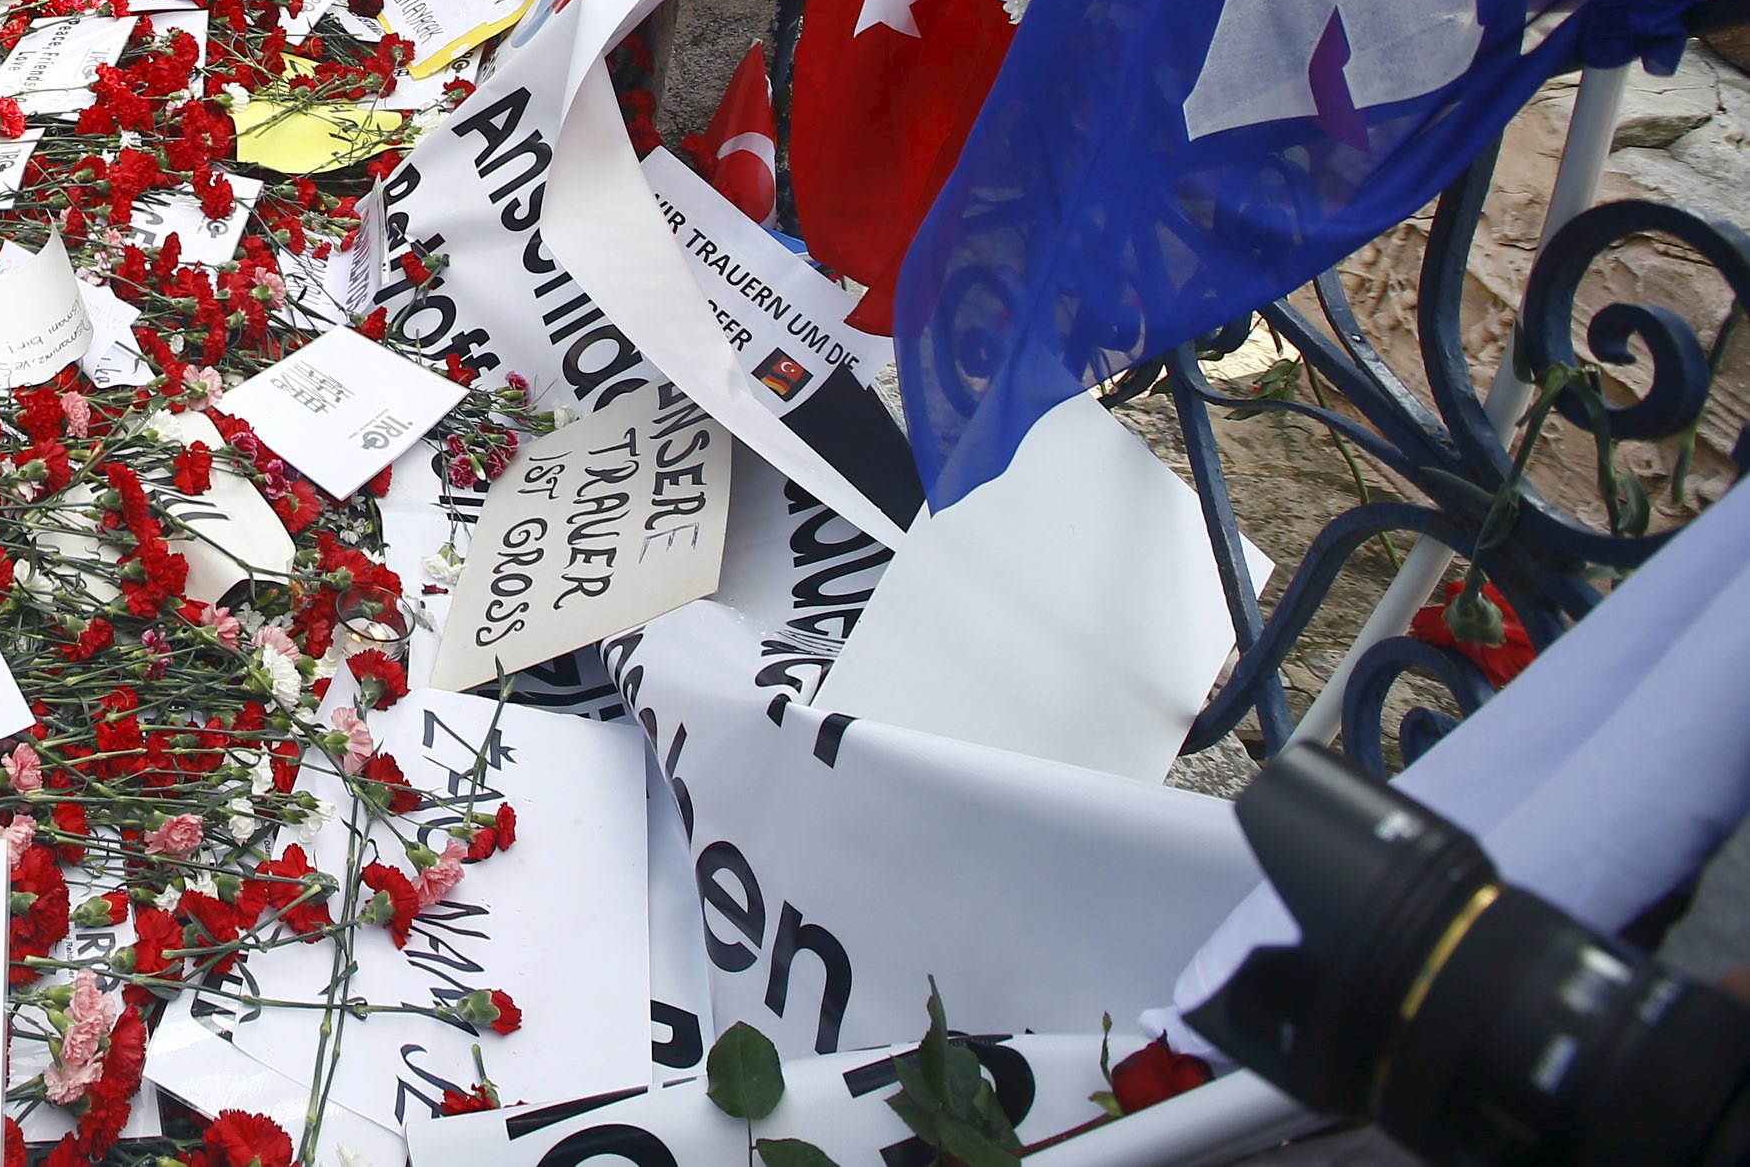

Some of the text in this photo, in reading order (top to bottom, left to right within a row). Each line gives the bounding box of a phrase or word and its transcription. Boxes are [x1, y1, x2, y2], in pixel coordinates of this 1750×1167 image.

[8, 51, 37, 72] Love
[685, 226, 806, 329] TRAUERN
[791, 309, 839, 354] UM
[474, 448, 560, 650] IST GROSS
[553, 426, 639, 612] TRAUER
[399, 899, 493, 1039] NAM
